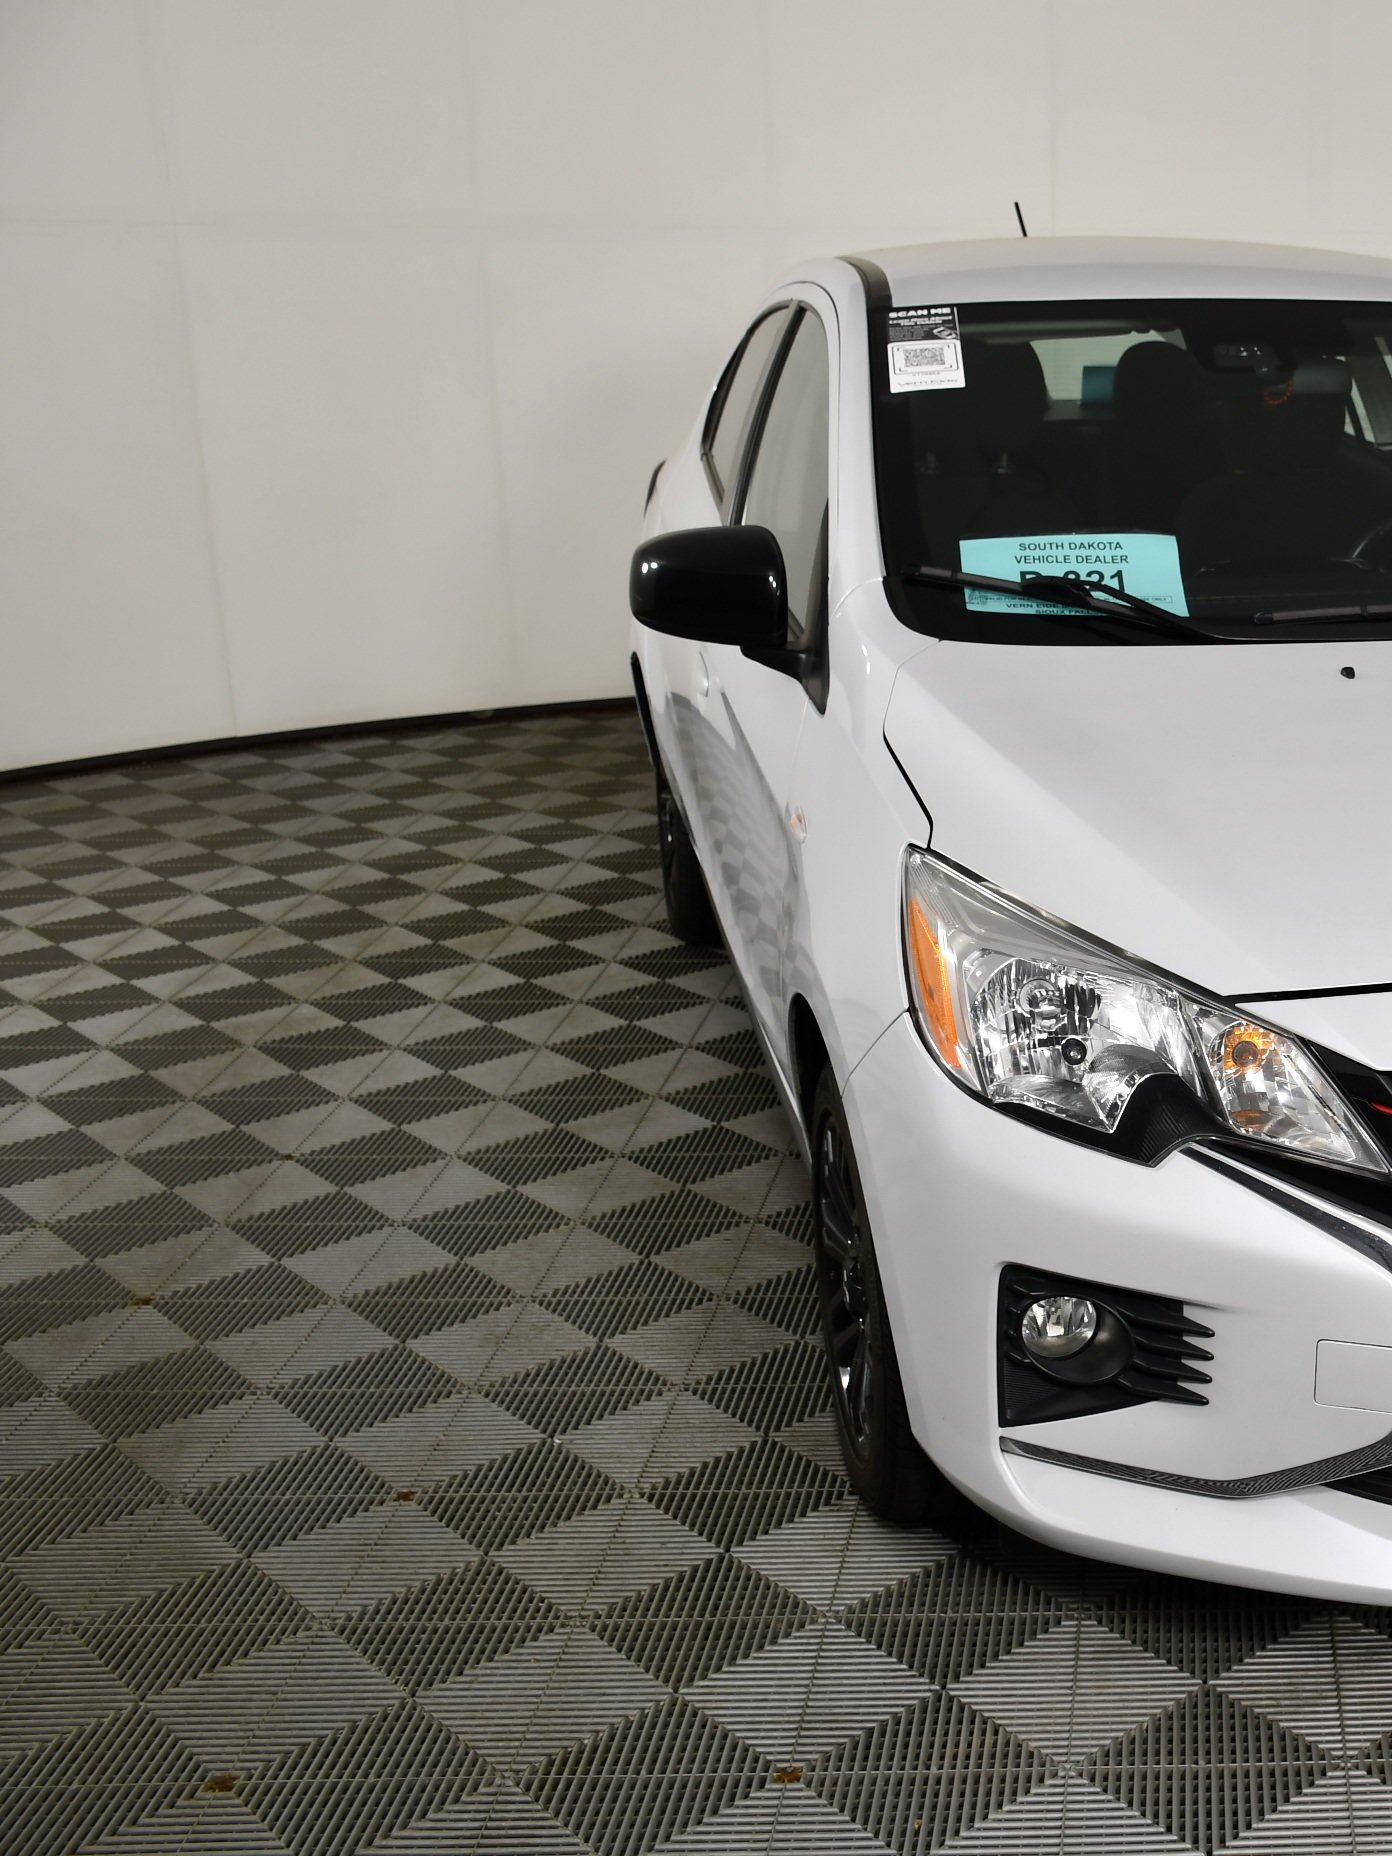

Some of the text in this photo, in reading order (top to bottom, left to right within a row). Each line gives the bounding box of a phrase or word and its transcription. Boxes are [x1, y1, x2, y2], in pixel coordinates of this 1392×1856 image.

[889, 309, 928, 318] SCAN
[1018, 541, 1123, 551] SOUTH DAKOTA
[1014, 554, 1129, 564] VEHICLE DEALER
